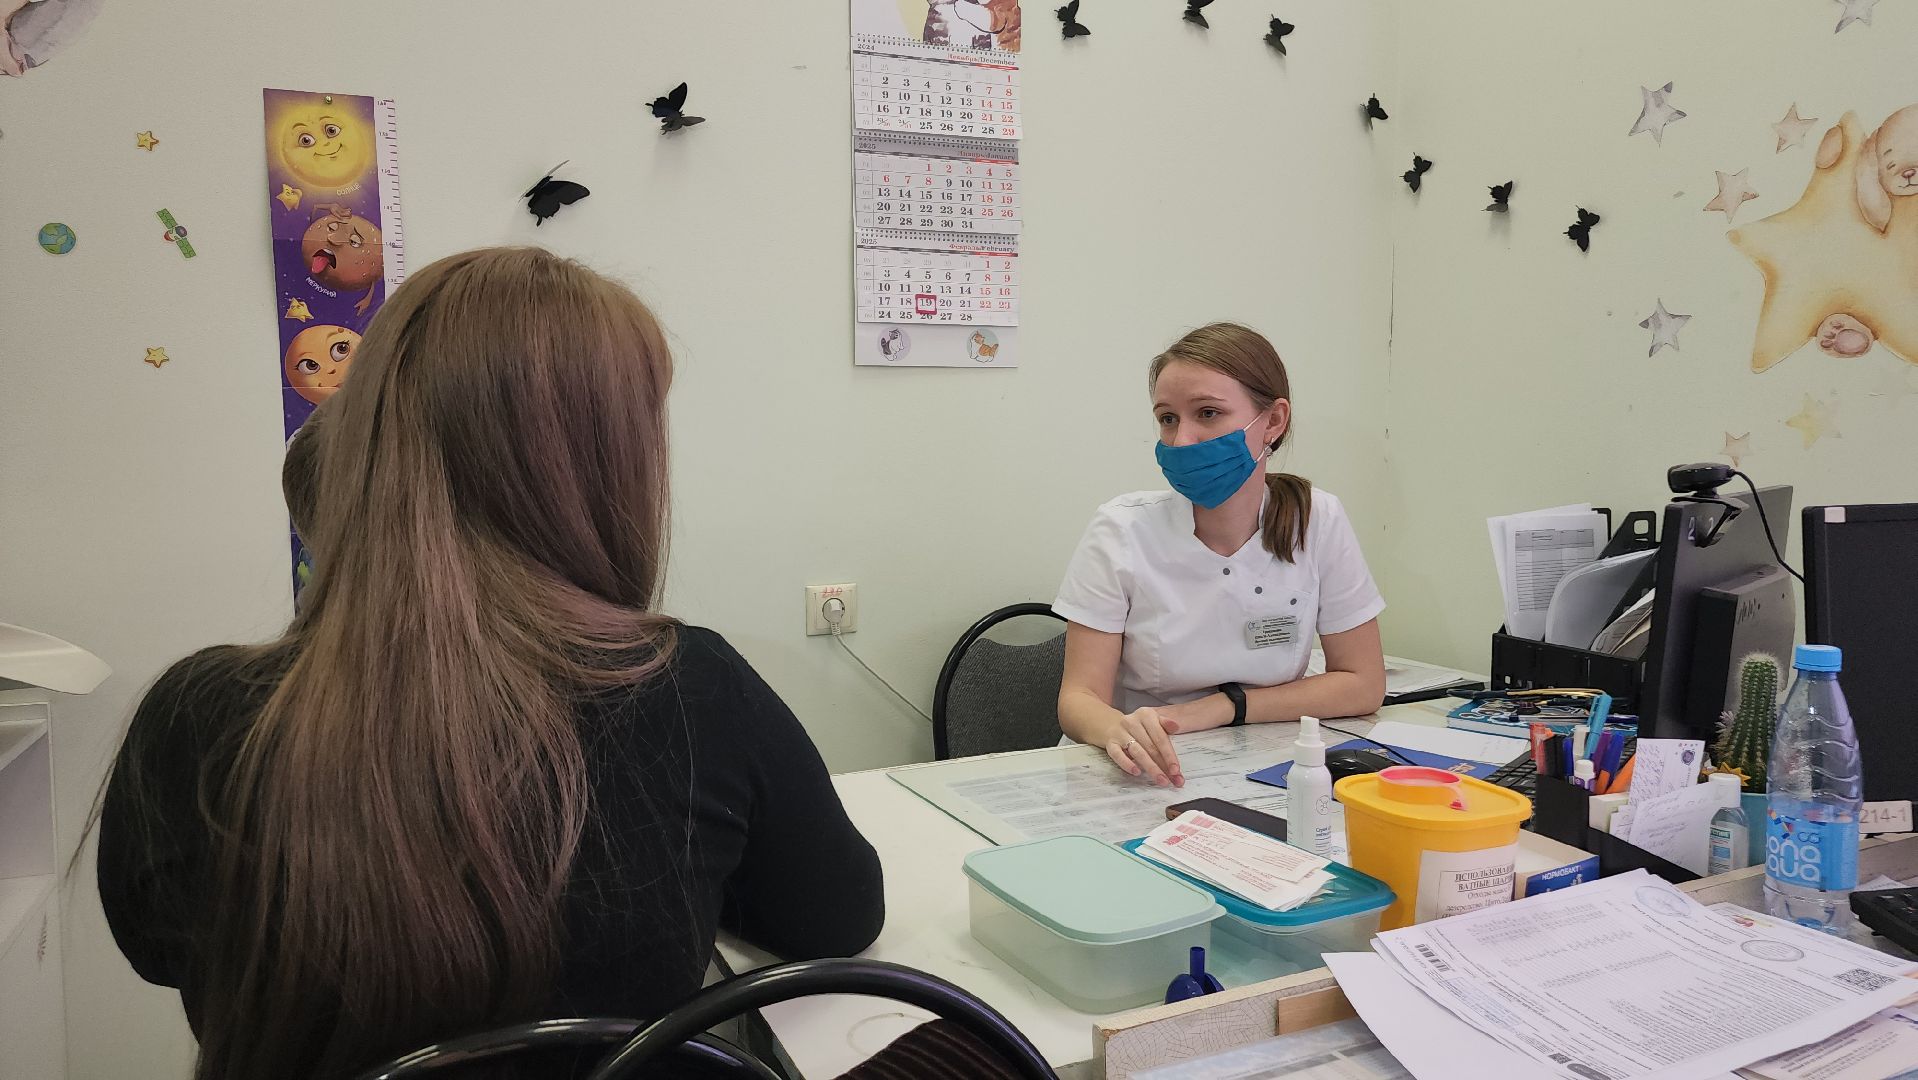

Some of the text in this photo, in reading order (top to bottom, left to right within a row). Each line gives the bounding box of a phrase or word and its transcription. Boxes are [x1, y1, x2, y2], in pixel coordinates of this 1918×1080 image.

[881, 76, 1013, 97] 2 3 4 5 6 7 8
[898, 91, 911, 102] 10
[919, 93, 932, 104] 11
[940, 95, 953, 105] 12
[959, 97, 973, 107] 13
[981, 99, 993, 109] 14
[1000, 101, 1013, 110] 15
[877, 104, 890, 114] 16
[898, 105, 911, 115] 17
[919, 107, 932, 117] 18
[939, 109, 953, 119] 19
[959, 111, 974, 120] 20
[981, 112, 994, 122] 21
[1001, 114, 1014, 124] 22
[919, 121, 933, 130] 25
[939, 122, 954, 132] 26
[960, 124, 974, 134] 27
[981, 126, 995, 135] 28
[945, 164, 953, 174] 2
[965, 165, 973, 175] 3
[985, 167, 993, 177] 4
[1005, 169, 1013, 178] 5
[883, 174, 890, 183] 6
[904, 175, 912, 185] 7
[925, 176, 932, 186] 8
[945, 178, 953, 188] 9
[959, 179, 973, 189] 10
[981, 180, 993, 190] 11
[1000, 182, 1013, 191] 12
[876, 187, 891, 198] 13
[898, 188, 912, 199] 14
[919, 190, 933, 200] 15
[940, 191, 953, 201] 16
[959, 193, 973, 202] 17
[981, 194, 994, 204] 18
[1000, 195, 1013, 205] 19
[876, 201, 891, 212] 20
[899, 202, 911, 212] 21
[919, 204, 934, 214] 22
[939, 205, 954, 215] 23
[960, 206, 974, 216] 24
[981, 207, 994, 217] 25
[1000, 209, 1014, 218] 26
[877, 215, 892, 225] 27
[899, 216, 913, 226] 28
[919, 218, 934, 227] 29
[940, 219, 954, 229] 30
[961, 220, 973, 229] 31
[1004, 260, 1011, 270] 2
[904, 269, 911, 279] 4
[924, 270, 932, 280] 5
[945, 271, 952, 281] 6
[964, 272, 971, 282] 7
[984, 273, 991, 282] 8
[1004, 274, 1011, 283] 9
[305, 275, 337, 297] МЕРКУРИЙ
[878, 282, 891, 292] 10
[899, 283, 912, 293] 11
[919, 284, 932, 294] 12
[939, 285, 952, 294] 13
[959, 285, 972, 295] 14
[979, 287, 992, 296] 15
[877, 296, 891, 306] 17
[900, 297, 913, 306] 18
[919, 297, 934, 307] 19
[938, 298, 953, 308] 20
[959, 299, 971, 308] 21
[979, 300, 992, 309] 22
[878, 310, 892, 319] 24
[899, 310, 913, 320] 25
[918, 311, 934, 320] 26
[939, 312, 953, 321] 27
[959, 312, 973, 322] 28
